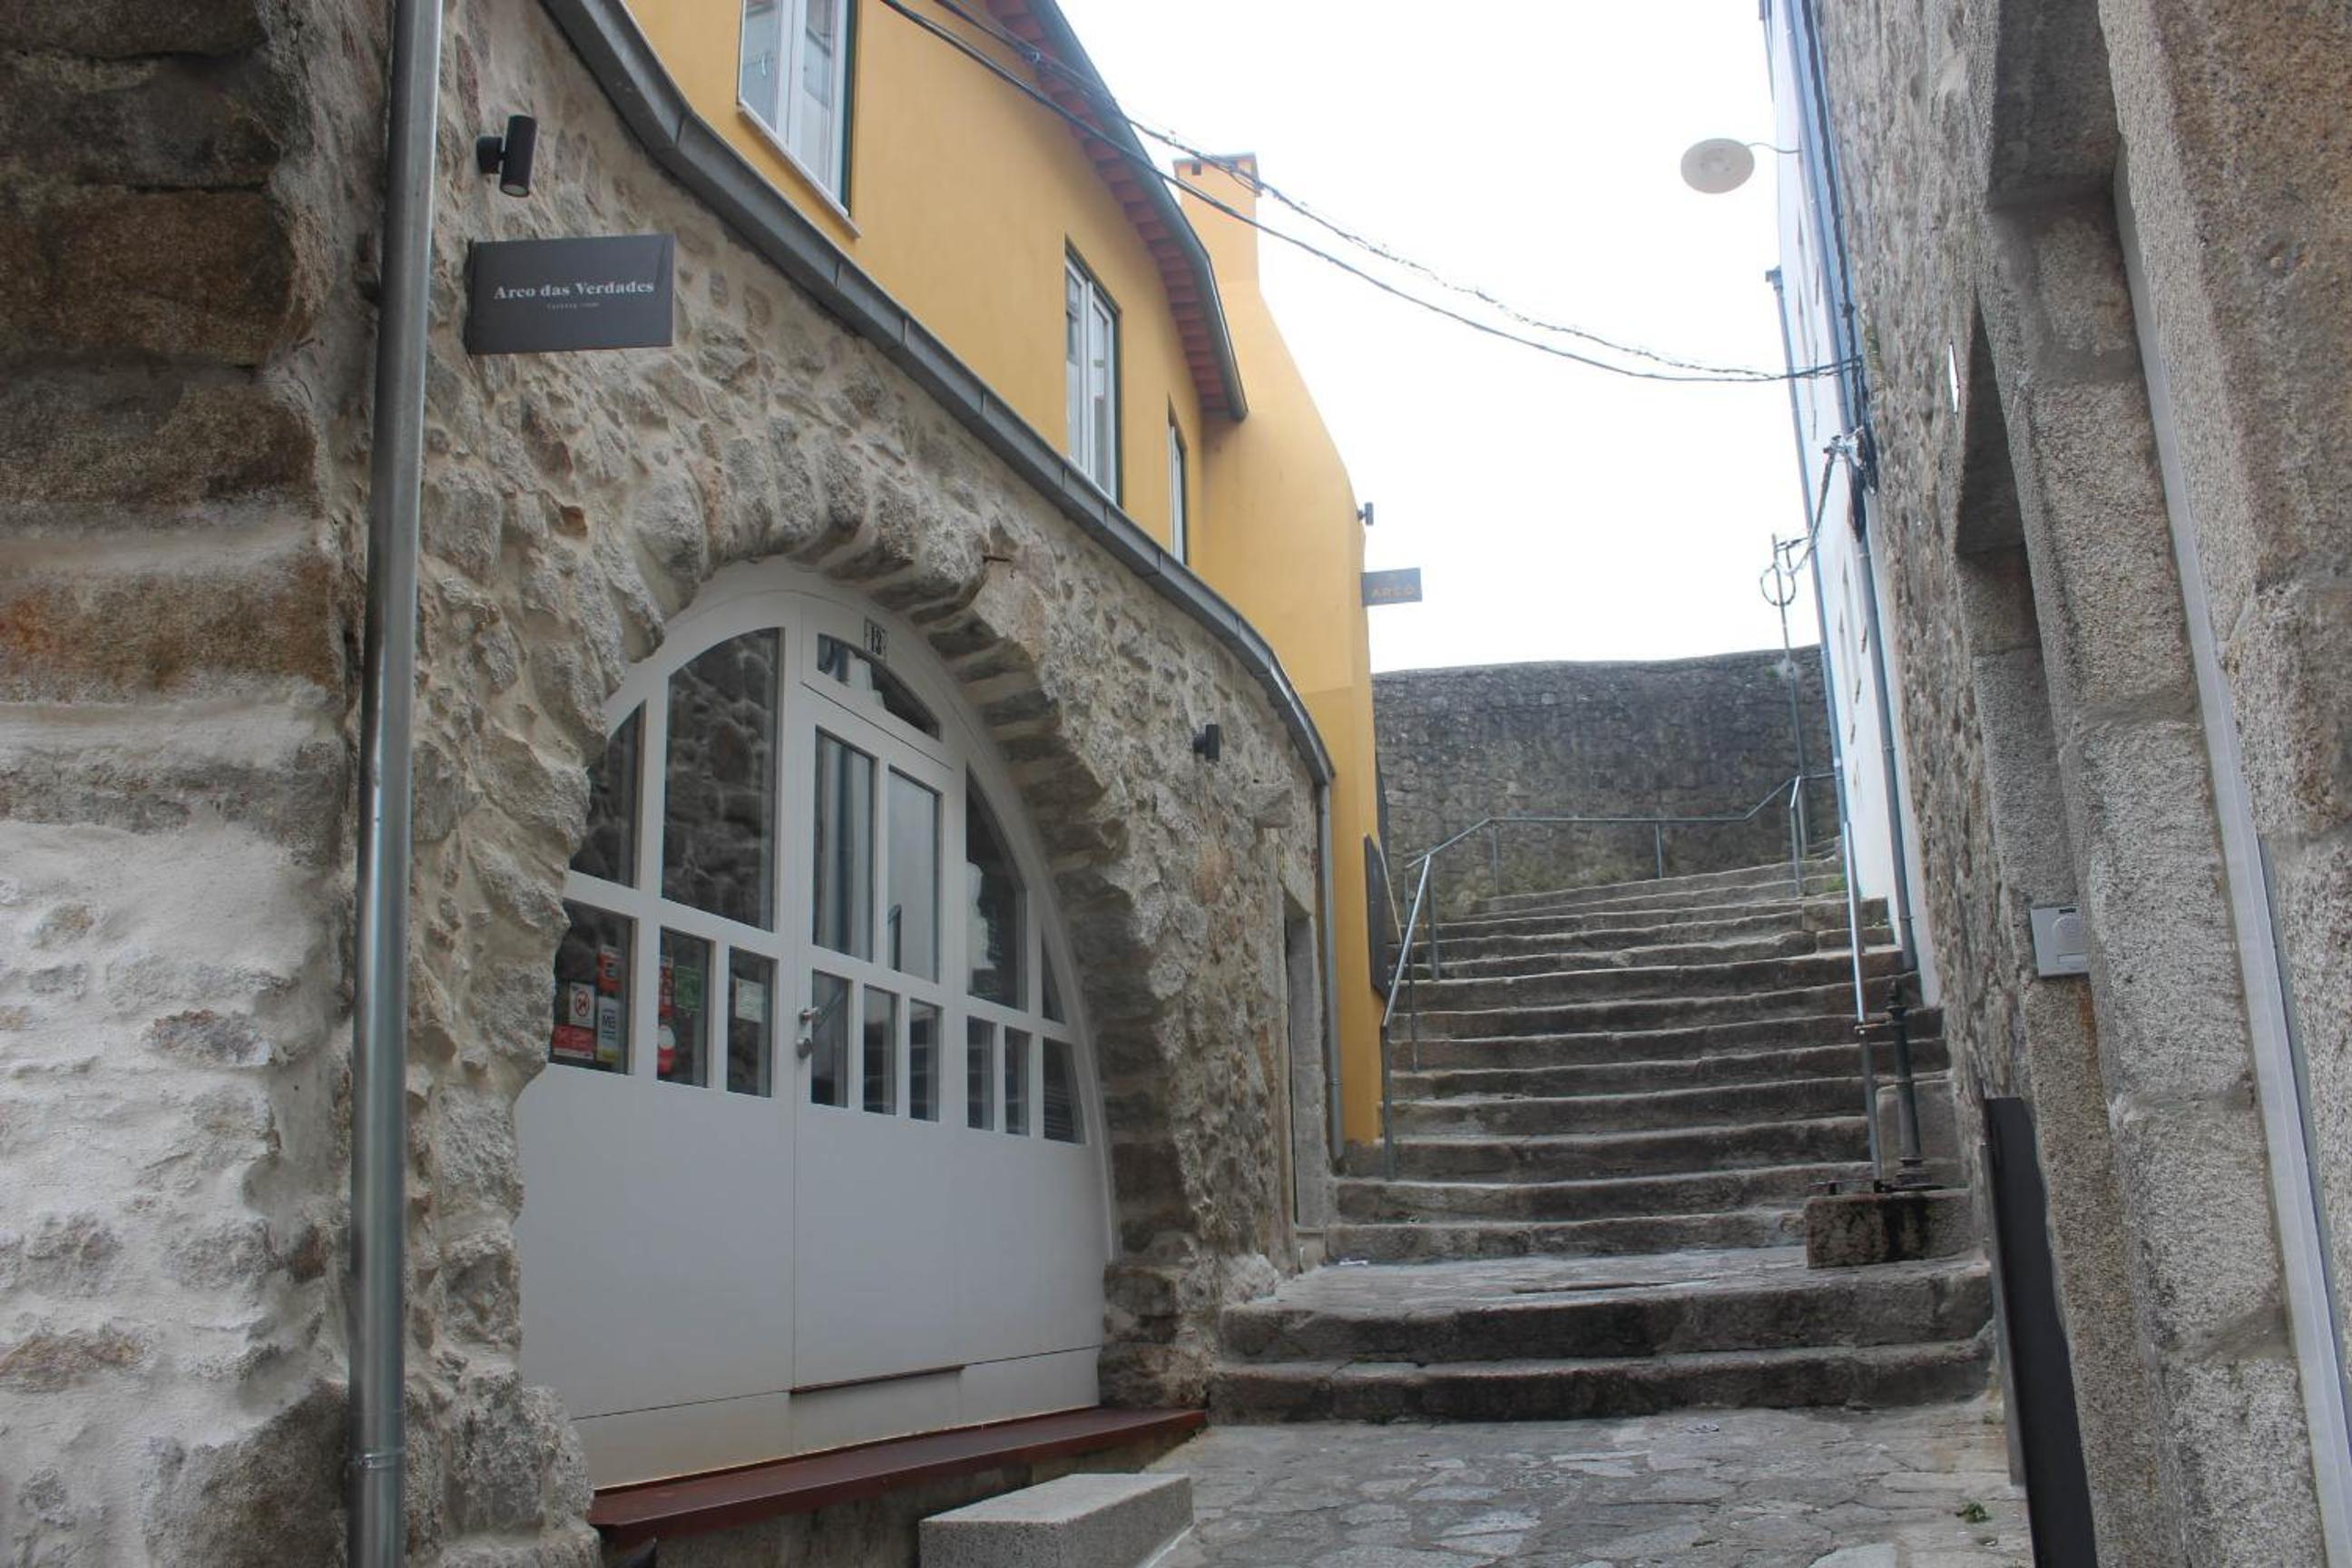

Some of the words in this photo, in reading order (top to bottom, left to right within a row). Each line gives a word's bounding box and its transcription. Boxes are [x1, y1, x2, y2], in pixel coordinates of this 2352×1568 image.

[494, 286, 535, 299] Arco
[540, 283, 570, 297] das
[574, 281, 655, 295] Verdades
